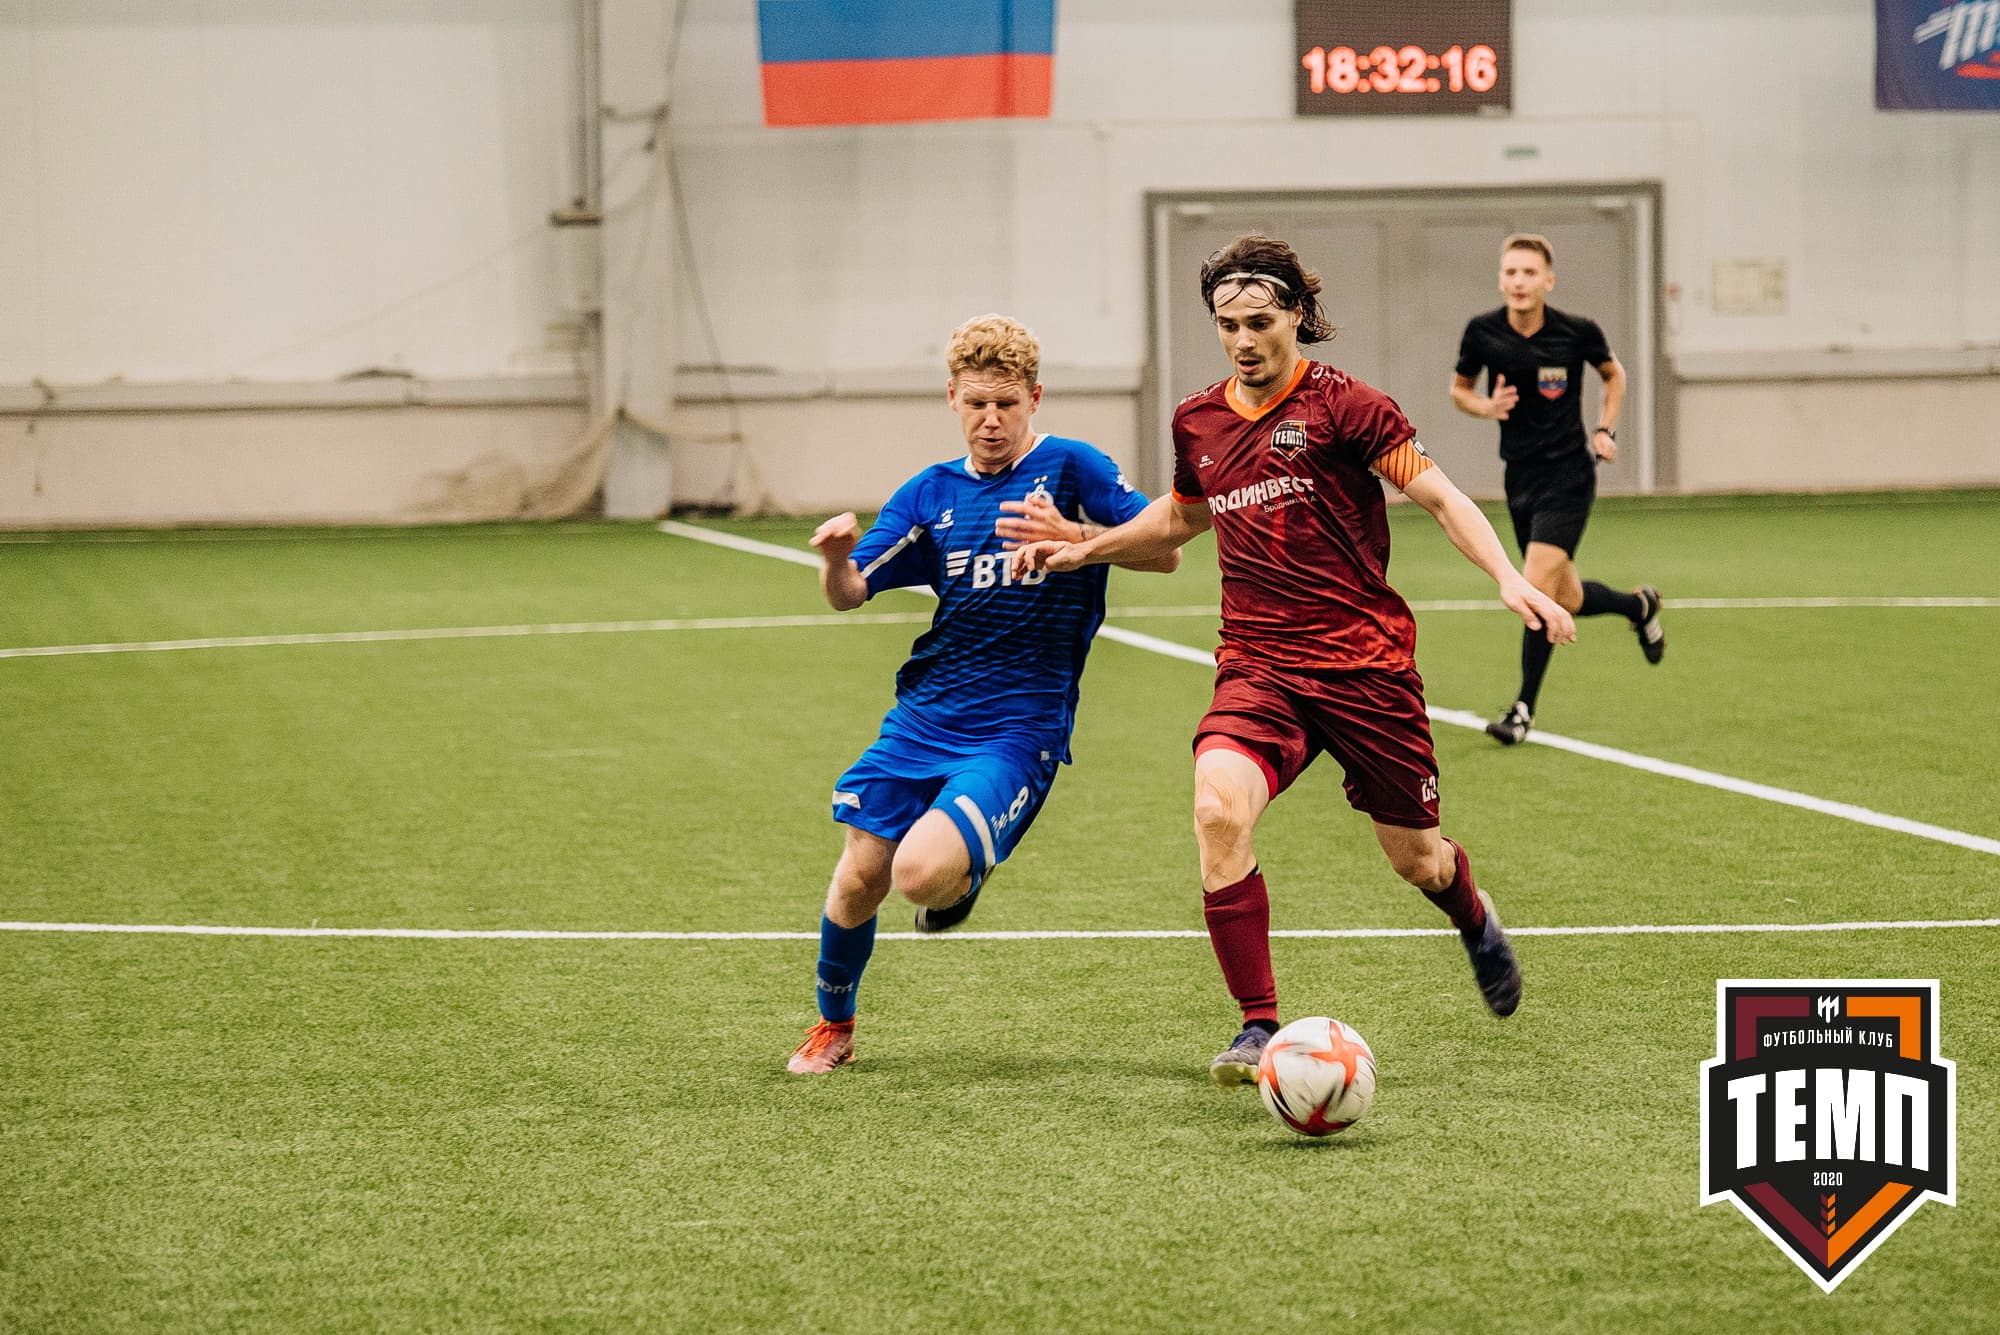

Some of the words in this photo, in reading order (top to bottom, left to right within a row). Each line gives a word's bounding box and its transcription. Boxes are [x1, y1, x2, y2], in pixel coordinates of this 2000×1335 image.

[1301, 44, 1499, 94] 18:32:16
[1274, 430, 1304, 446] ТЕМП
[1008, 785, 1029, 822] 8
